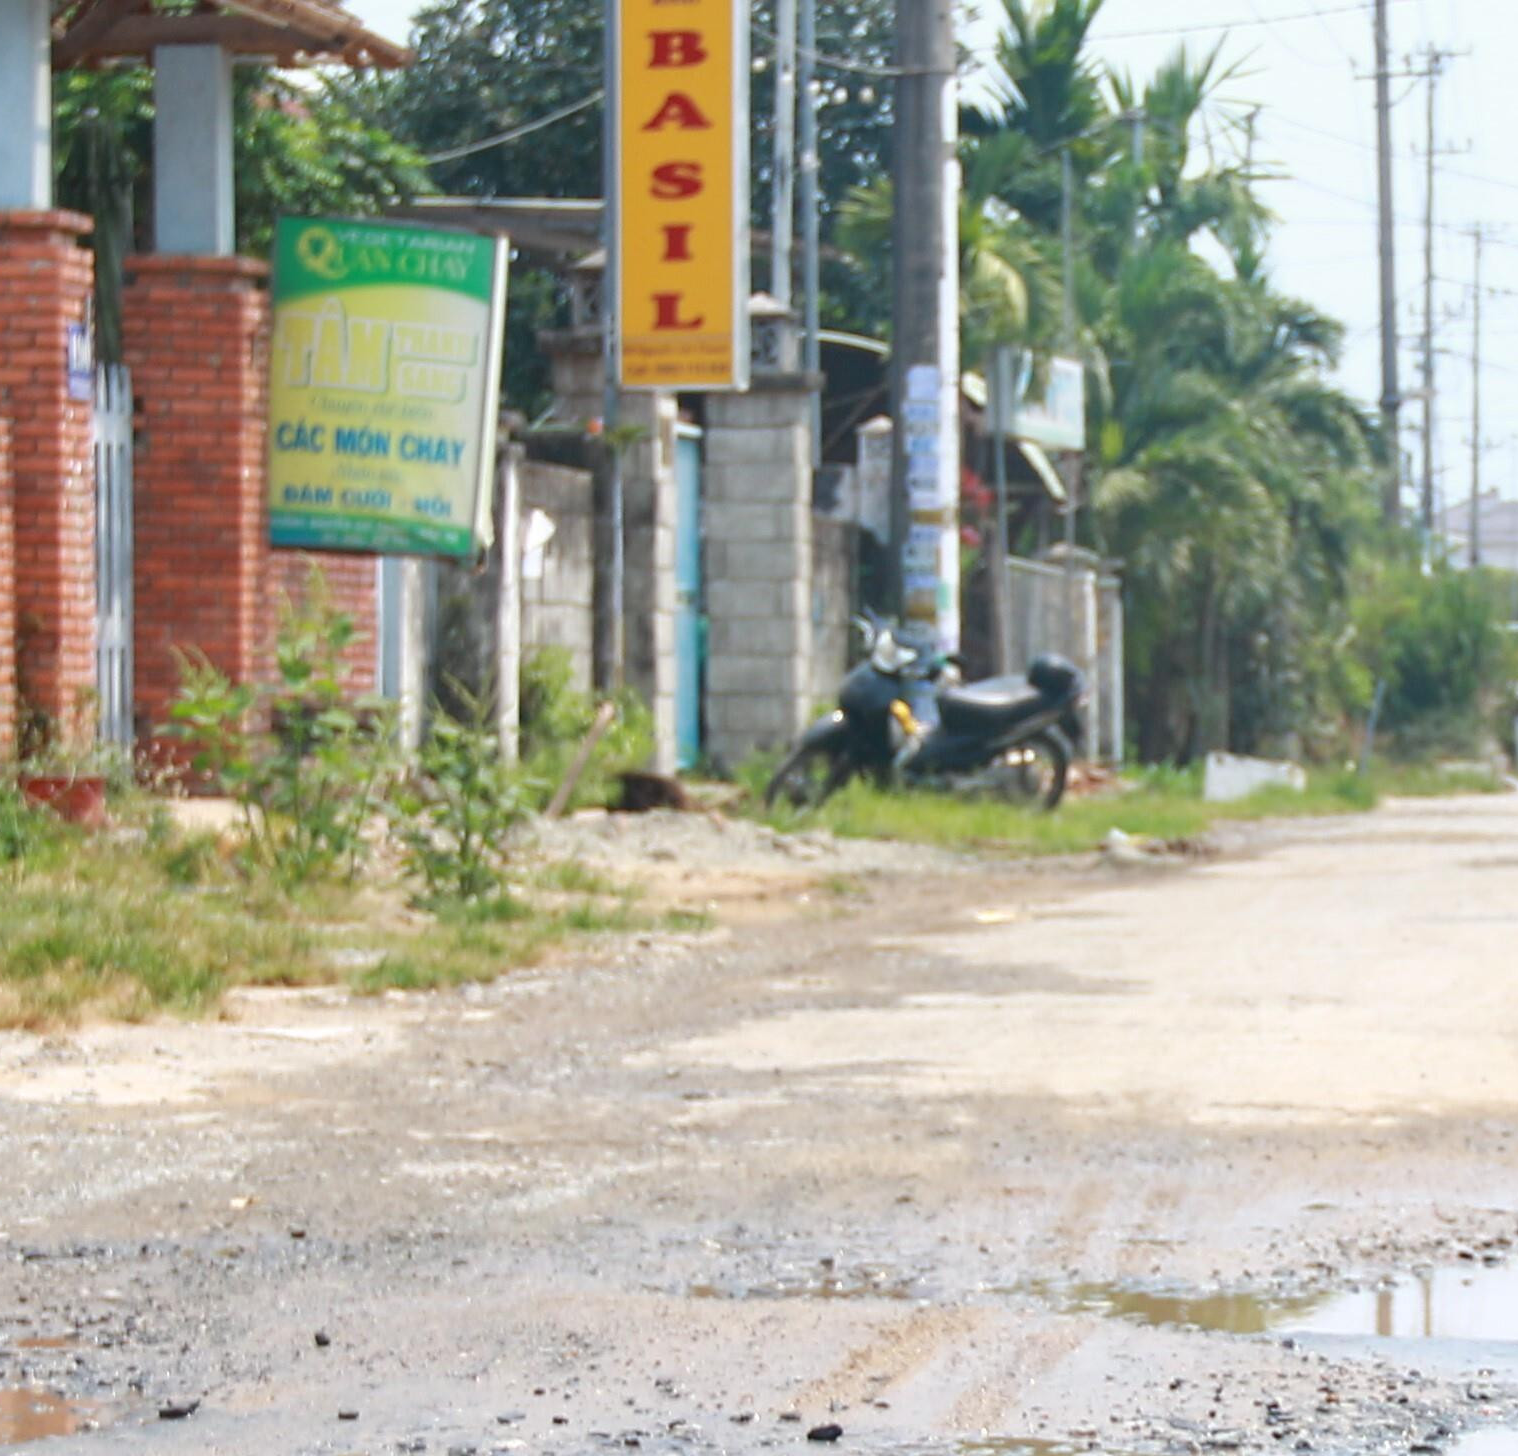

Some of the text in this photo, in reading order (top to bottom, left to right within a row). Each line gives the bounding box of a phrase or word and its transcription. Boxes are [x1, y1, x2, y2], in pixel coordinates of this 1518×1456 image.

[276, 417, 466, 468] CÁC MÓN CHAY
